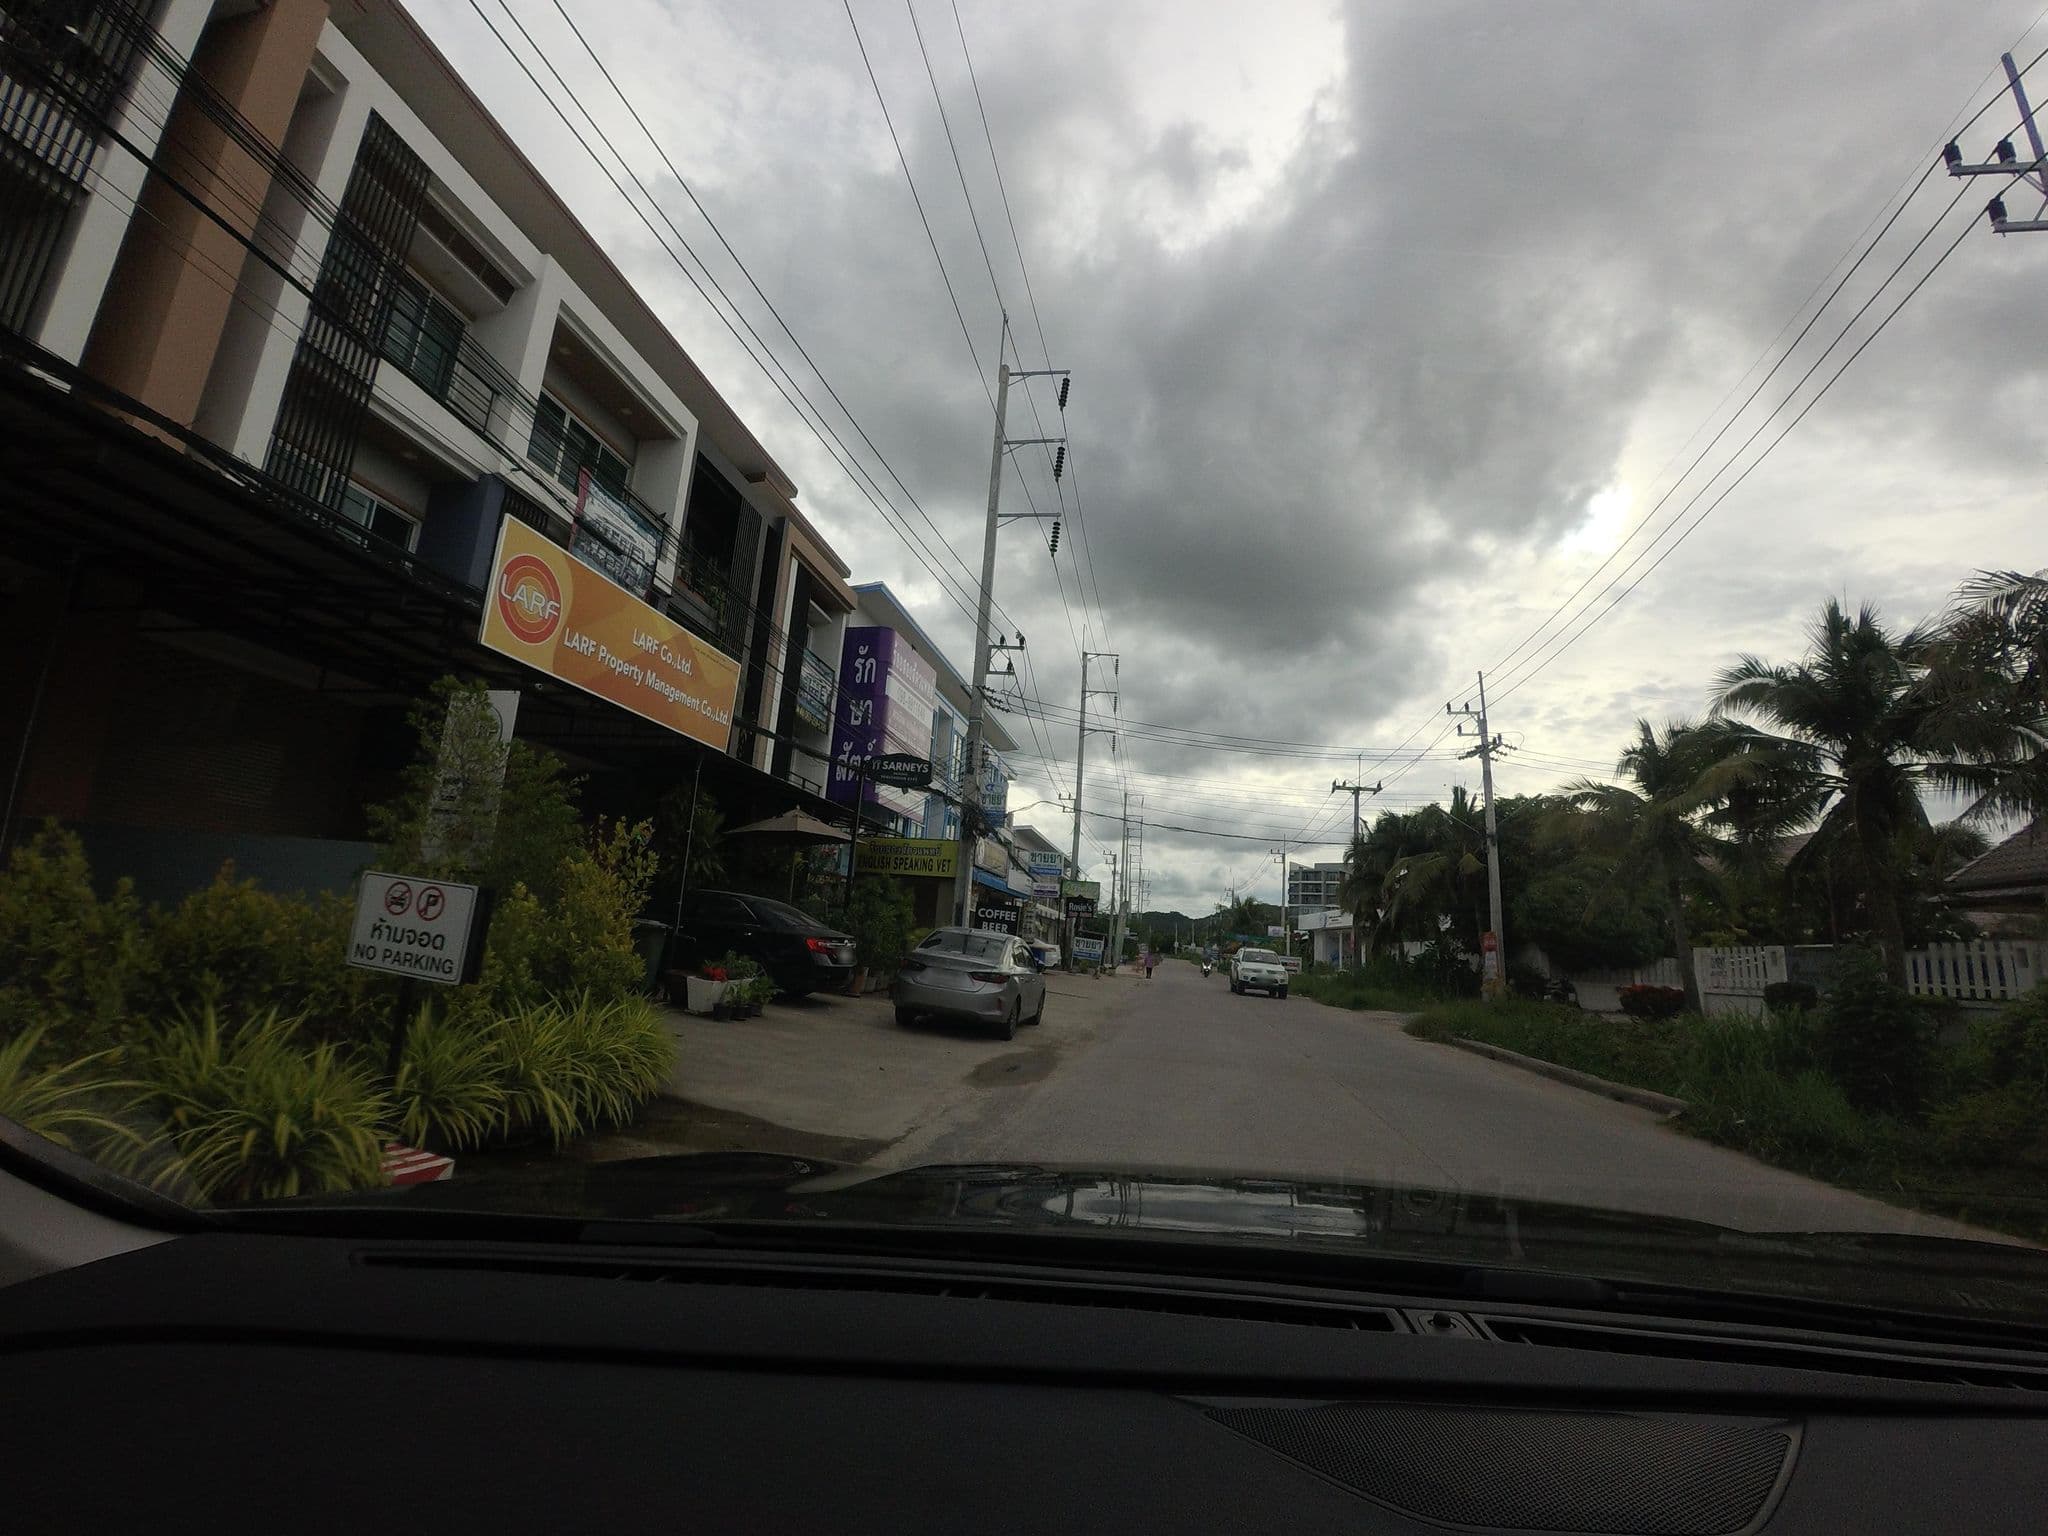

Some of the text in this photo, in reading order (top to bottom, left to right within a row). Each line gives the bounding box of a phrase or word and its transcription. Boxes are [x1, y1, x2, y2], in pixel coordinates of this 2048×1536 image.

[499, 573, 561, 620] LARF
[632, 628, 659, 652] LARF
[563, 627, 596, 657] LARF
[598, 643, 644, 687] Property
[645, 669, 701, 713] Management
[882, 760, 929, 773] SARNEYS
[893, 857, 933, 873] SPEAKING
[936, 859, 952, 873] VET
[978, 907, 1017, 922] COFFEE
[1068, 902, 1093, 912] Rosie's
[370, 918, 445, 951] ห้ามจอด
[982, 921, 1009, 934] BEER
[353, 943, 454, 975] NO PARKING
